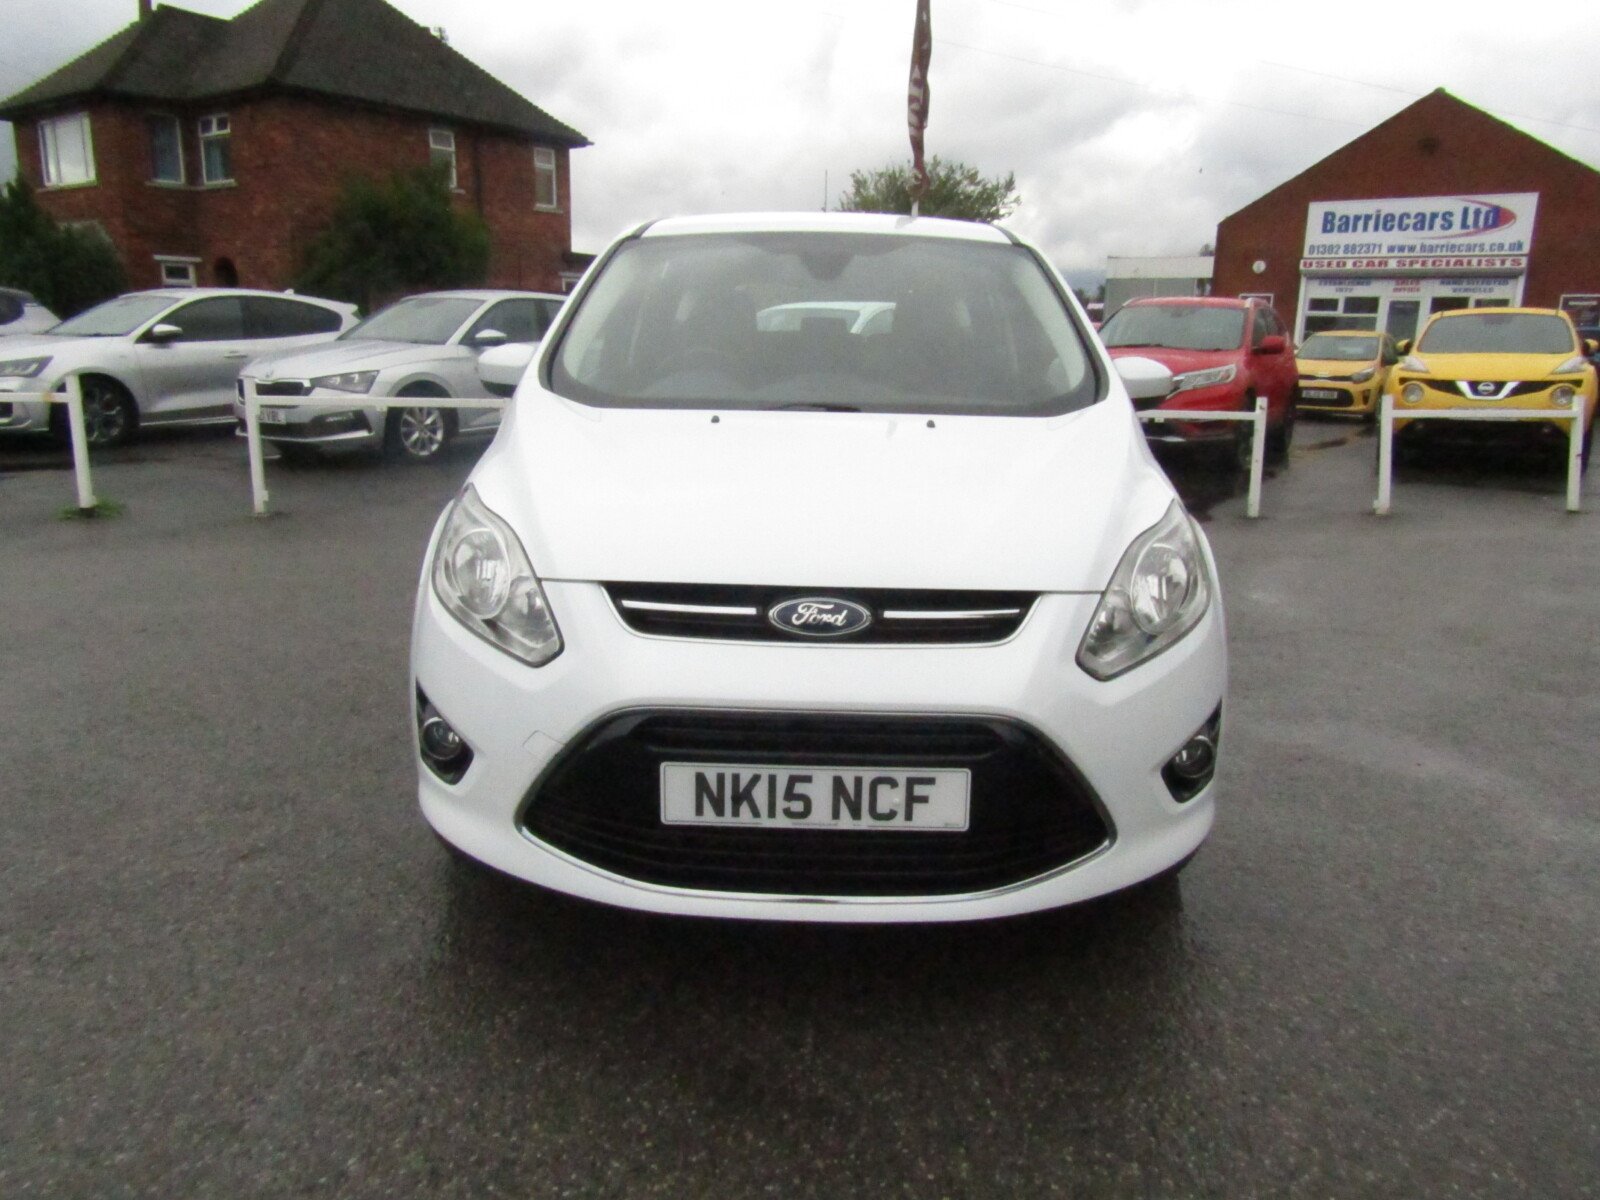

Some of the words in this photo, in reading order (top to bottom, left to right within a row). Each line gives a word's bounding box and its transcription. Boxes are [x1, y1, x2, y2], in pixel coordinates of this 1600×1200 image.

[1321, 209, 1454, 233] Barriecars
[1460, 206, 1500, 230] Ltd
[1387, 240, 1524, 254] www.barriecars.co.uk
[1302, 260, 1347, 268] USED
[1352, 260, 1389, 268] CAR
[1396, 257, 1523, 268] SPECIALISTS
[791, 602, 848, 626] Ford
[695, 771, 813, 819] NK15
[831, 775, 936, 822] NCF
